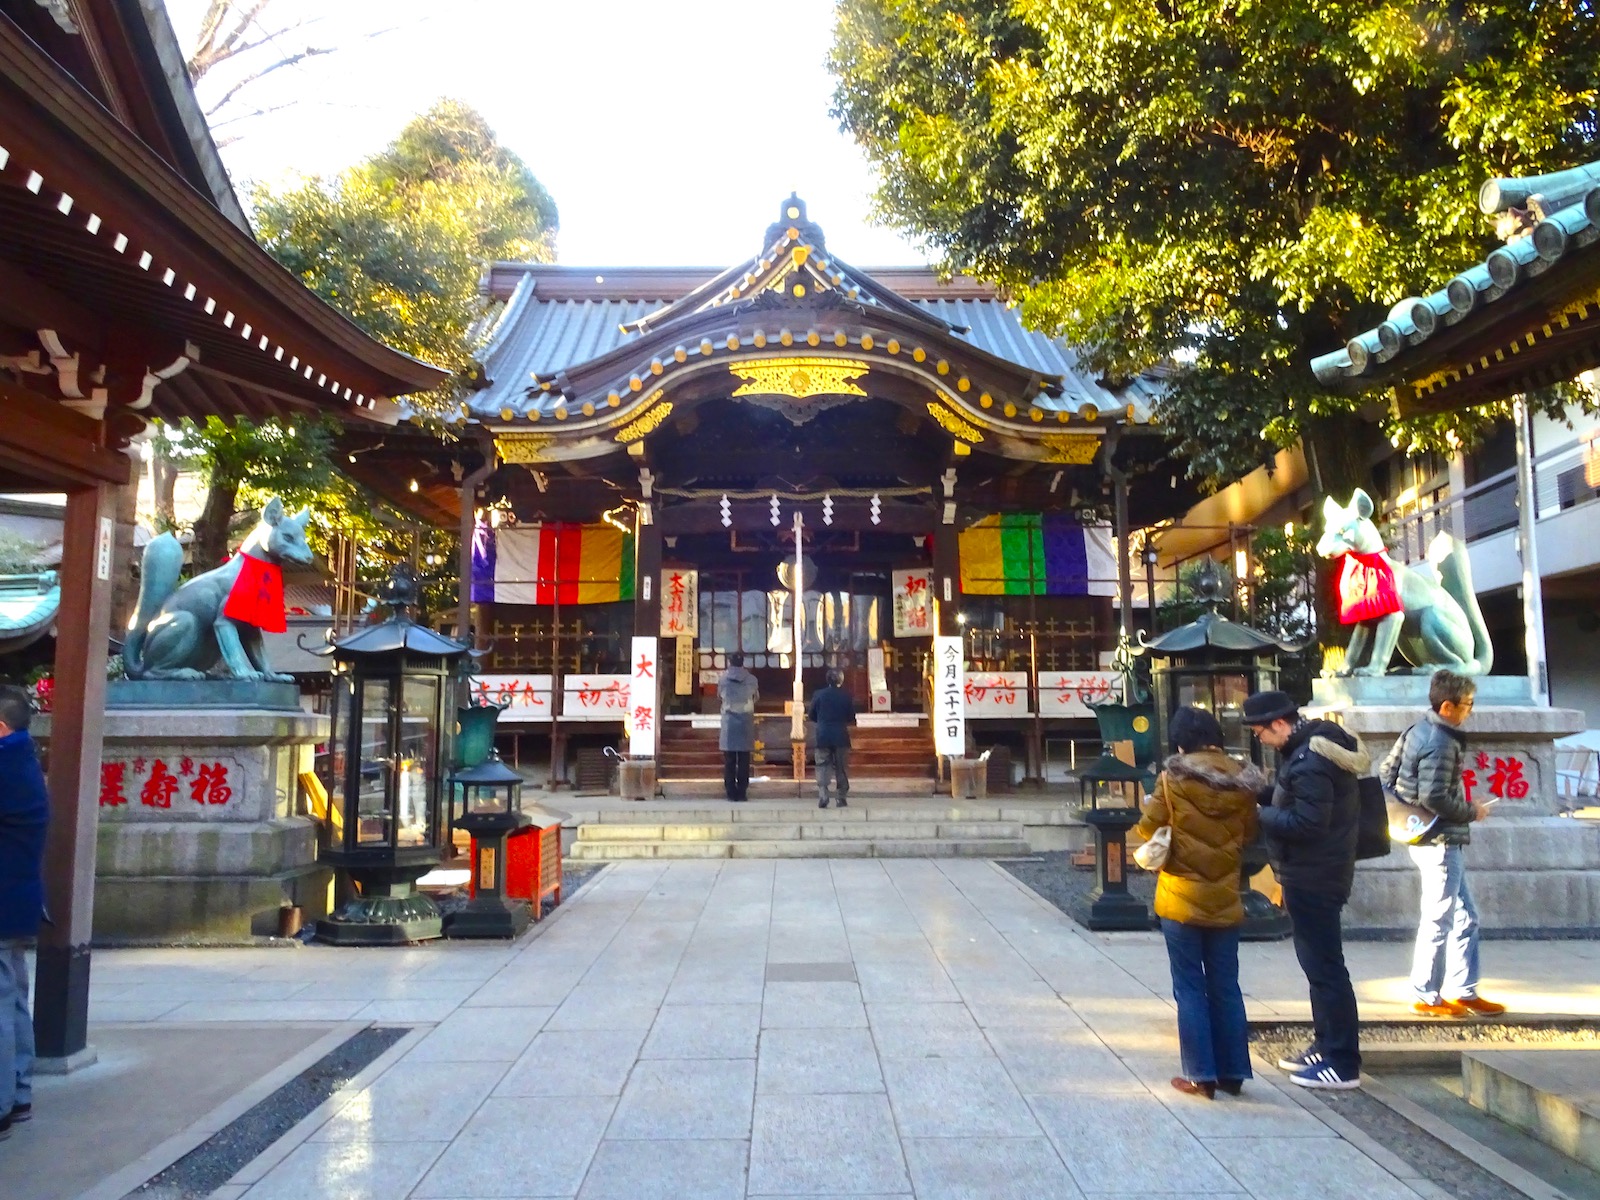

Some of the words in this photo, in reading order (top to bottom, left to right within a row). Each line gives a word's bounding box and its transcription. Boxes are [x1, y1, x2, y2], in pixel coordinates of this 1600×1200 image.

[577, 680, 631, 708] 初詣
[635, 653, 654, 731] 大祭
[944, 644, 961, 738] 今月二十二日
[963, 677, 1016, 705] 初詣
